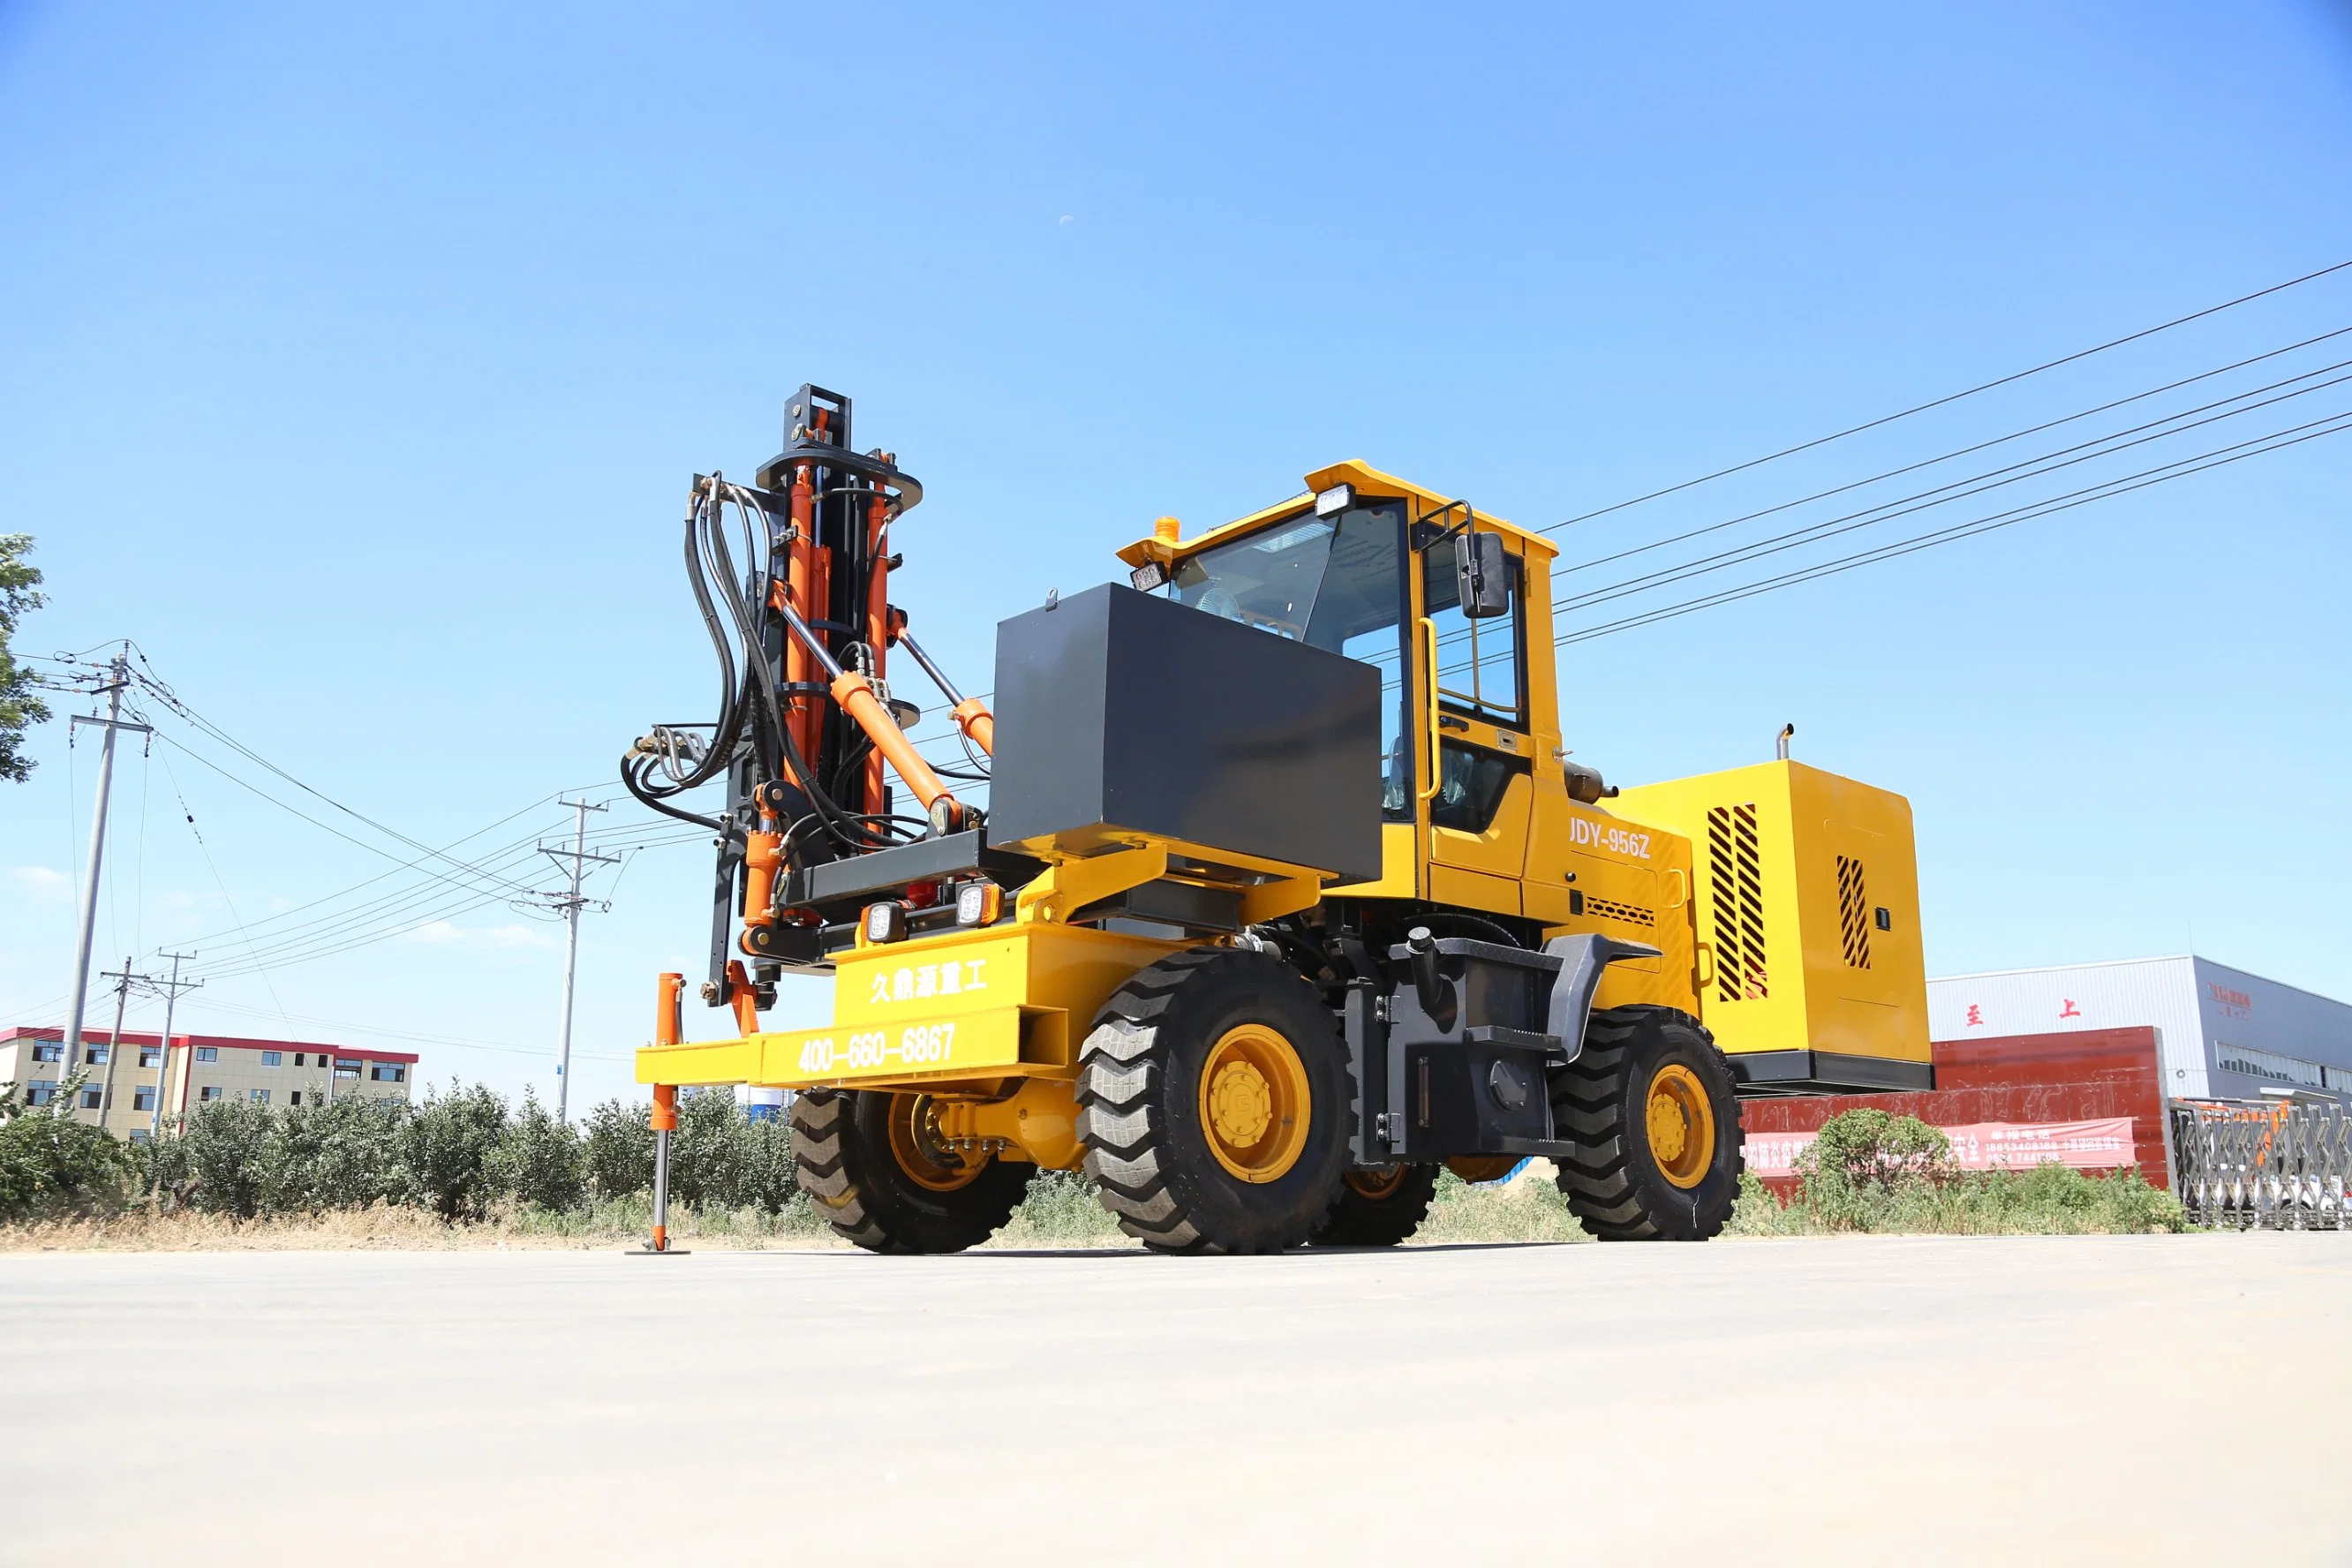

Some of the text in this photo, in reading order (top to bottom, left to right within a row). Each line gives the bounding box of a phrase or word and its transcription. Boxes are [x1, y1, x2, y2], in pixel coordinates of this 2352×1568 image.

[1570, 817, 1650, 859] JDY-956Z
[871, 960, 987, 1003] 久鼎源重工
[1965, 999, 2082, 1027] 至 上
[799, 1023, 955, 1073] 400-660-6867
